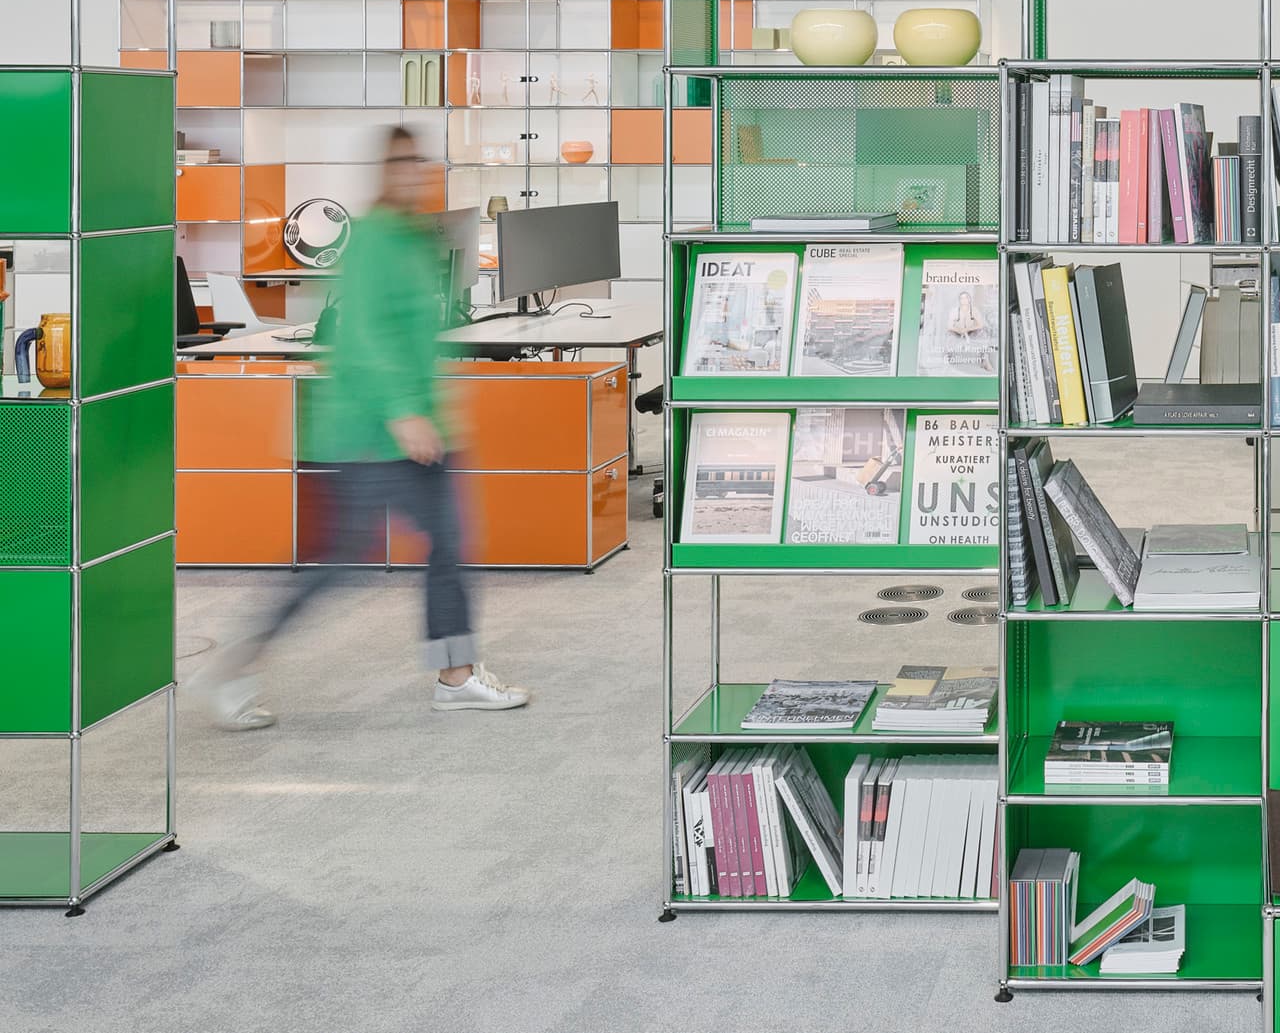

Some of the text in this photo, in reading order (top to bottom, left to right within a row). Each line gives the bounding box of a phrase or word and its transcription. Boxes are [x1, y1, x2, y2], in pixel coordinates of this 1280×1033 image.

[1247, 159, 1257, 213] Designrecht
[809, 248, 837, 258] CUBE
[701, 261, 756, 277] IDEAT
[1055, 314, 1076, 376] Neufert
[924, 419, 981, 431] B6 BAU
[718, 427, 766, 437] MAGAZIN
[928, 435, 999, 447] MEISTER:
[935, 455, 991, 464] KURATIERT
[950, 465, 975, 474] VON
[1020, 466, 1030, 487] desire
[1026, 500, 1036, 521] beauty
[929, 535, 990, 544] ON HEALTH
